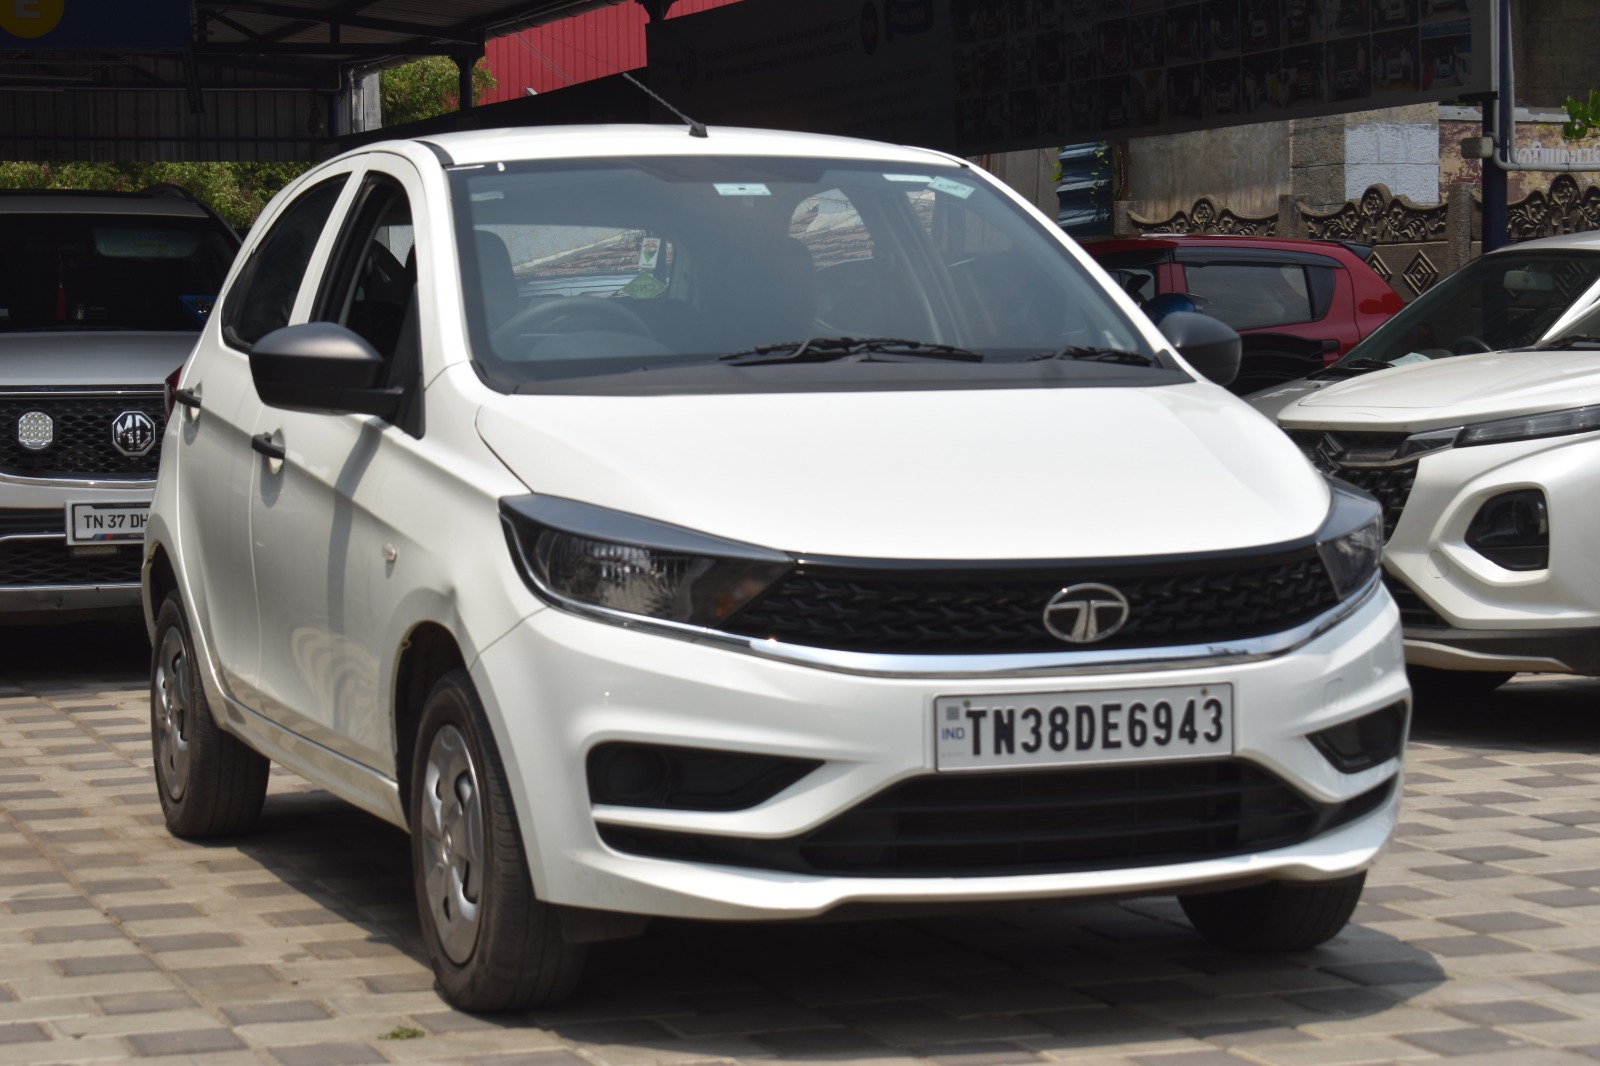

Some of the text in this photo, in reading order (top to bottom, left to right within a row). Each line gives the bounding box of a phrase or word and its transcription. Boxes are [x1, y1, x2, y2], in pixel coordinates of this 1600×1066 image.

[117, 414, 152, 451] MG
[84, 514, 103, 529] TN
[107, 514, 126, 529] 37
[941, 727, 965, 741] IND
[966, 698, 1223, 756] TN38DE6943
